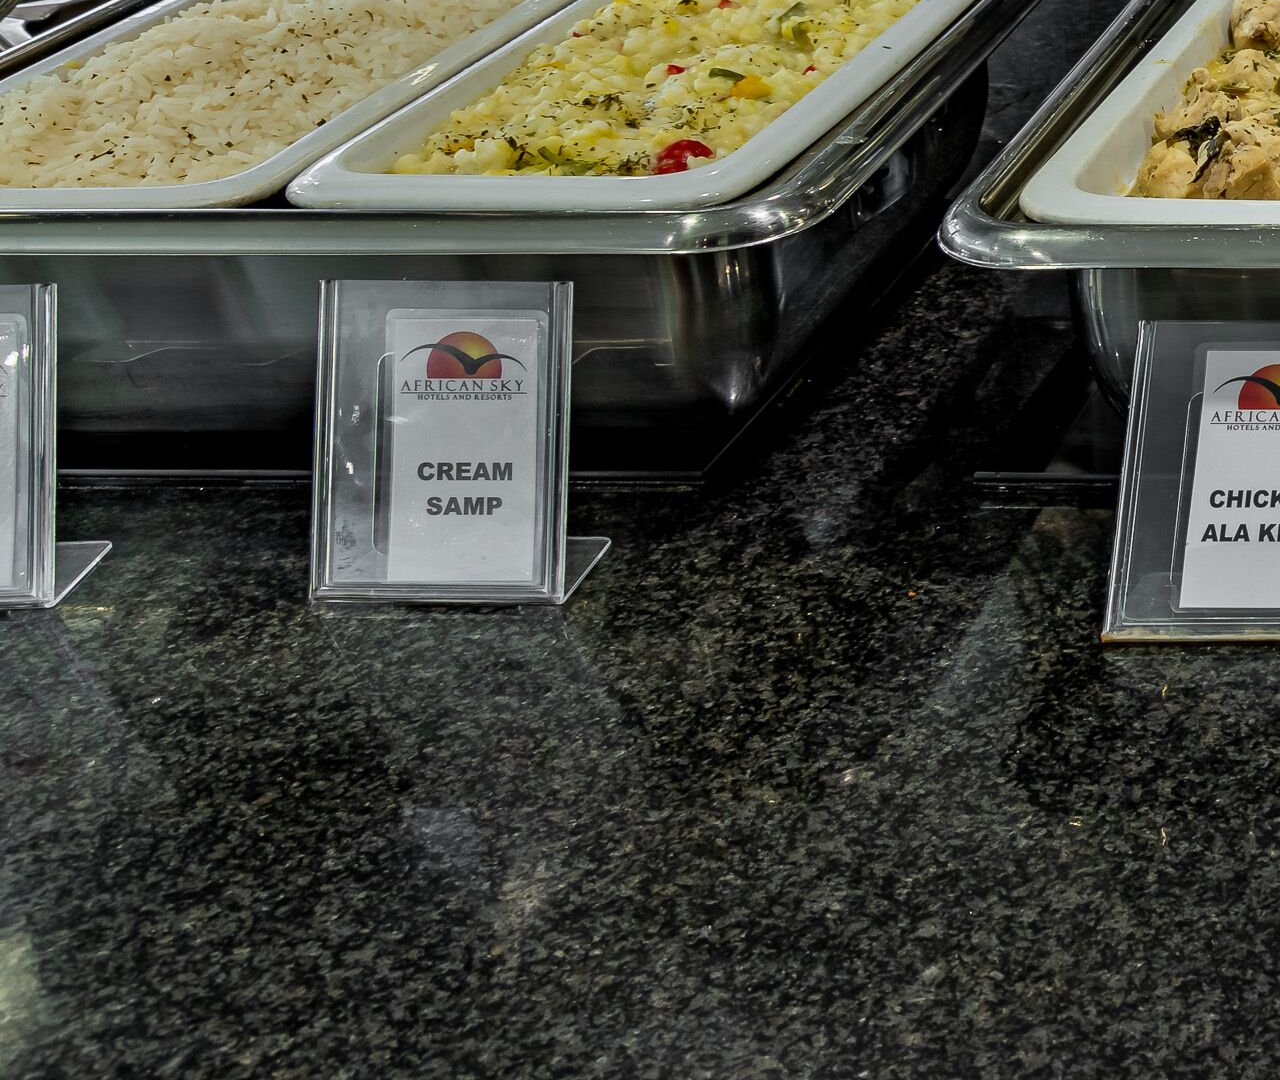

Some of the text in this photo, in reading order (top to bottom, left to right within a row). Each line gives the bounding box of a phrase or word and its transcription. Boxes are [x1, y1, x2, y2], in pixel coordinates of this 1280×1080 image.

[401, 380, 524, 392] AFRICAN SKY
[417, 462, 513, 481] CREAM
[426, 496, 503, 515] SAMP
[1201, 523, 1250, 542] ALA
